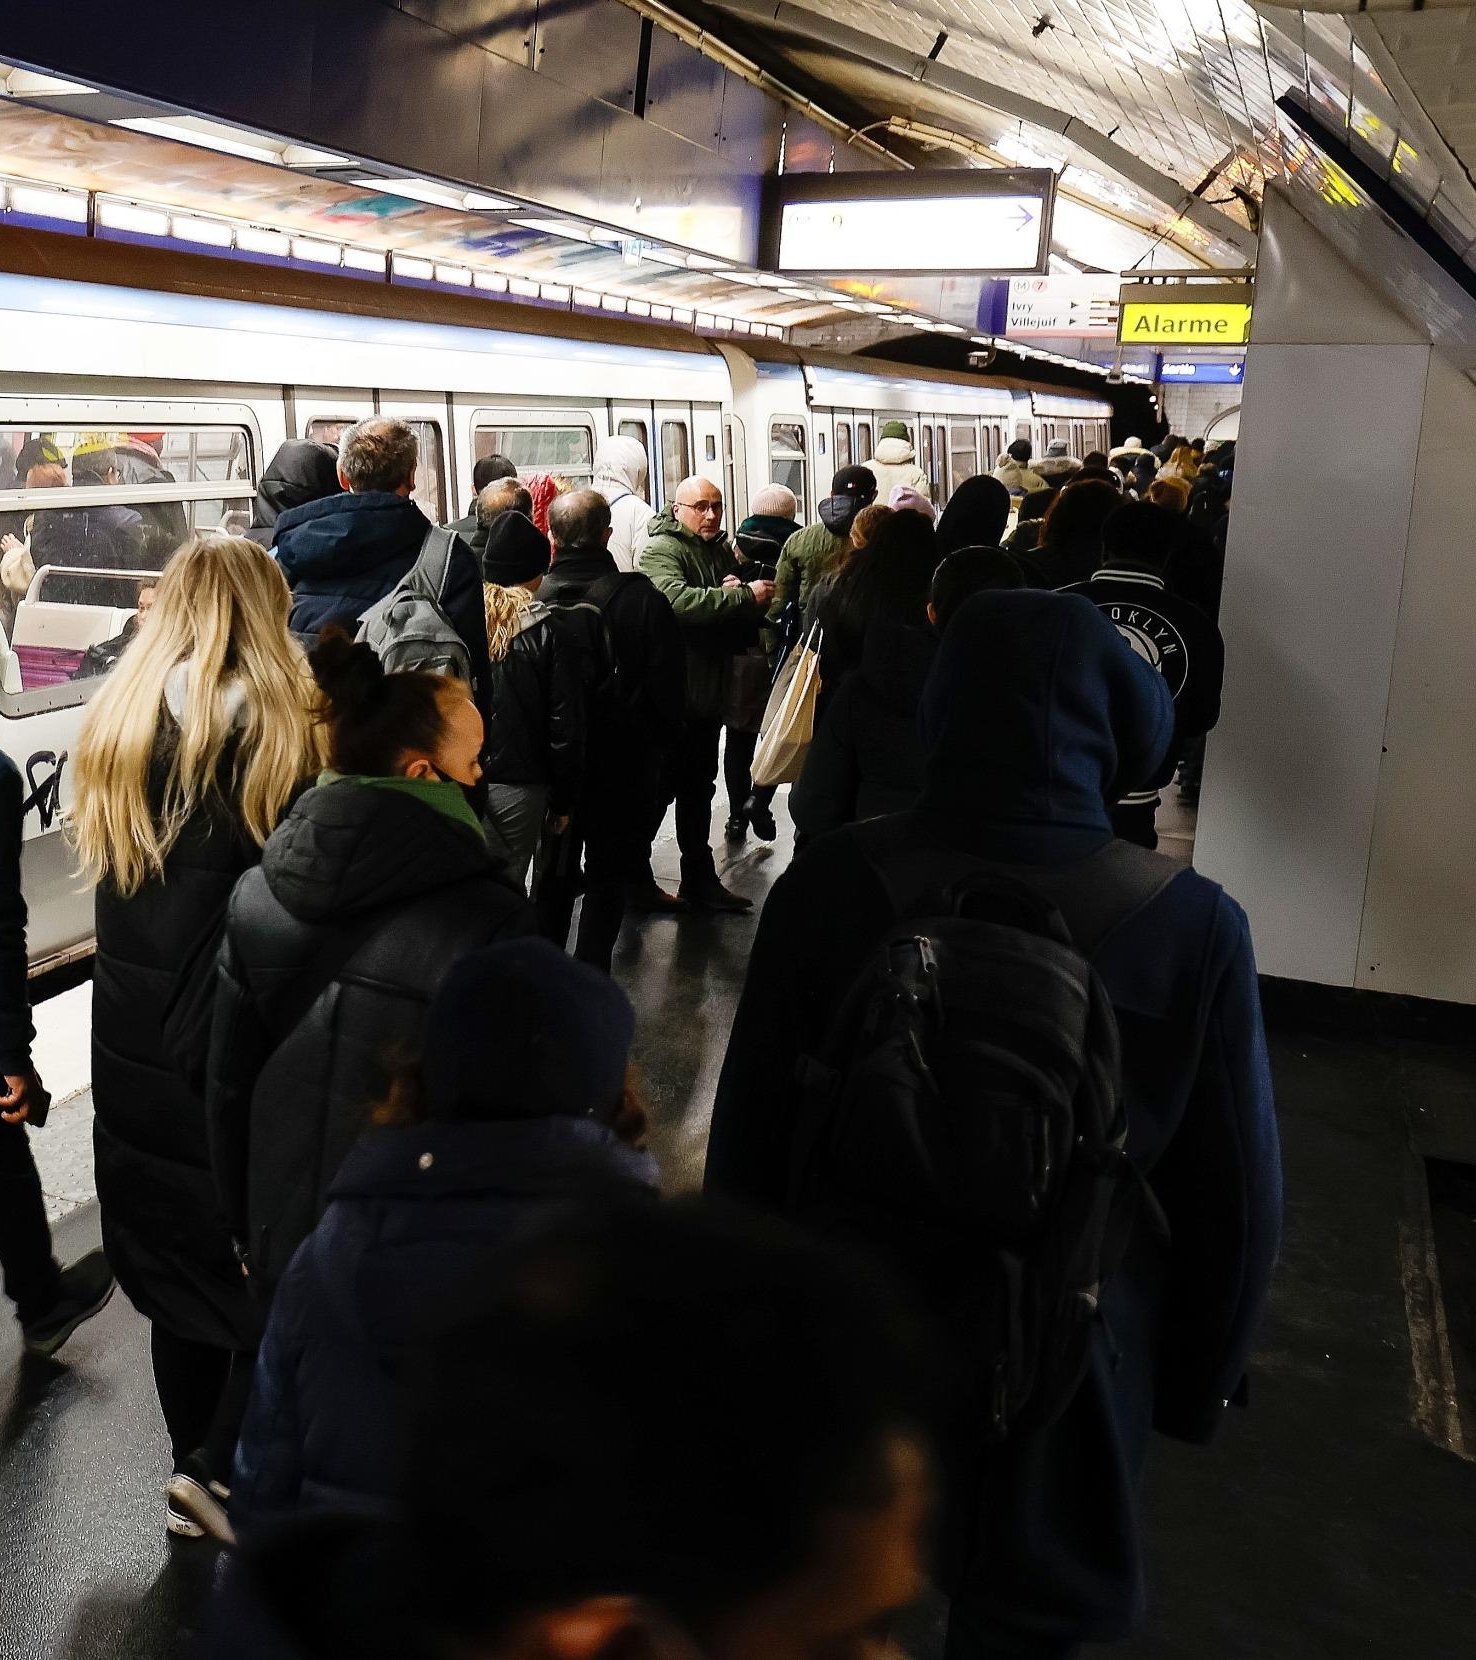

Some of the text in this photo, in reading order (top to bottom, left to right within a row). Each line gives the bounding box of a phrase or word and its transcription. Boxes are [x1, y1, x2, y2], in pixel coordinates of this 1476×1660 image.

[1012, 302, 1034, 312] Ivry
[1011, 318, 1058, 329] Villejuif
[1134, 314, 1229, 334] Alarme
[1111, 607, 1177, 655] OKLYN
